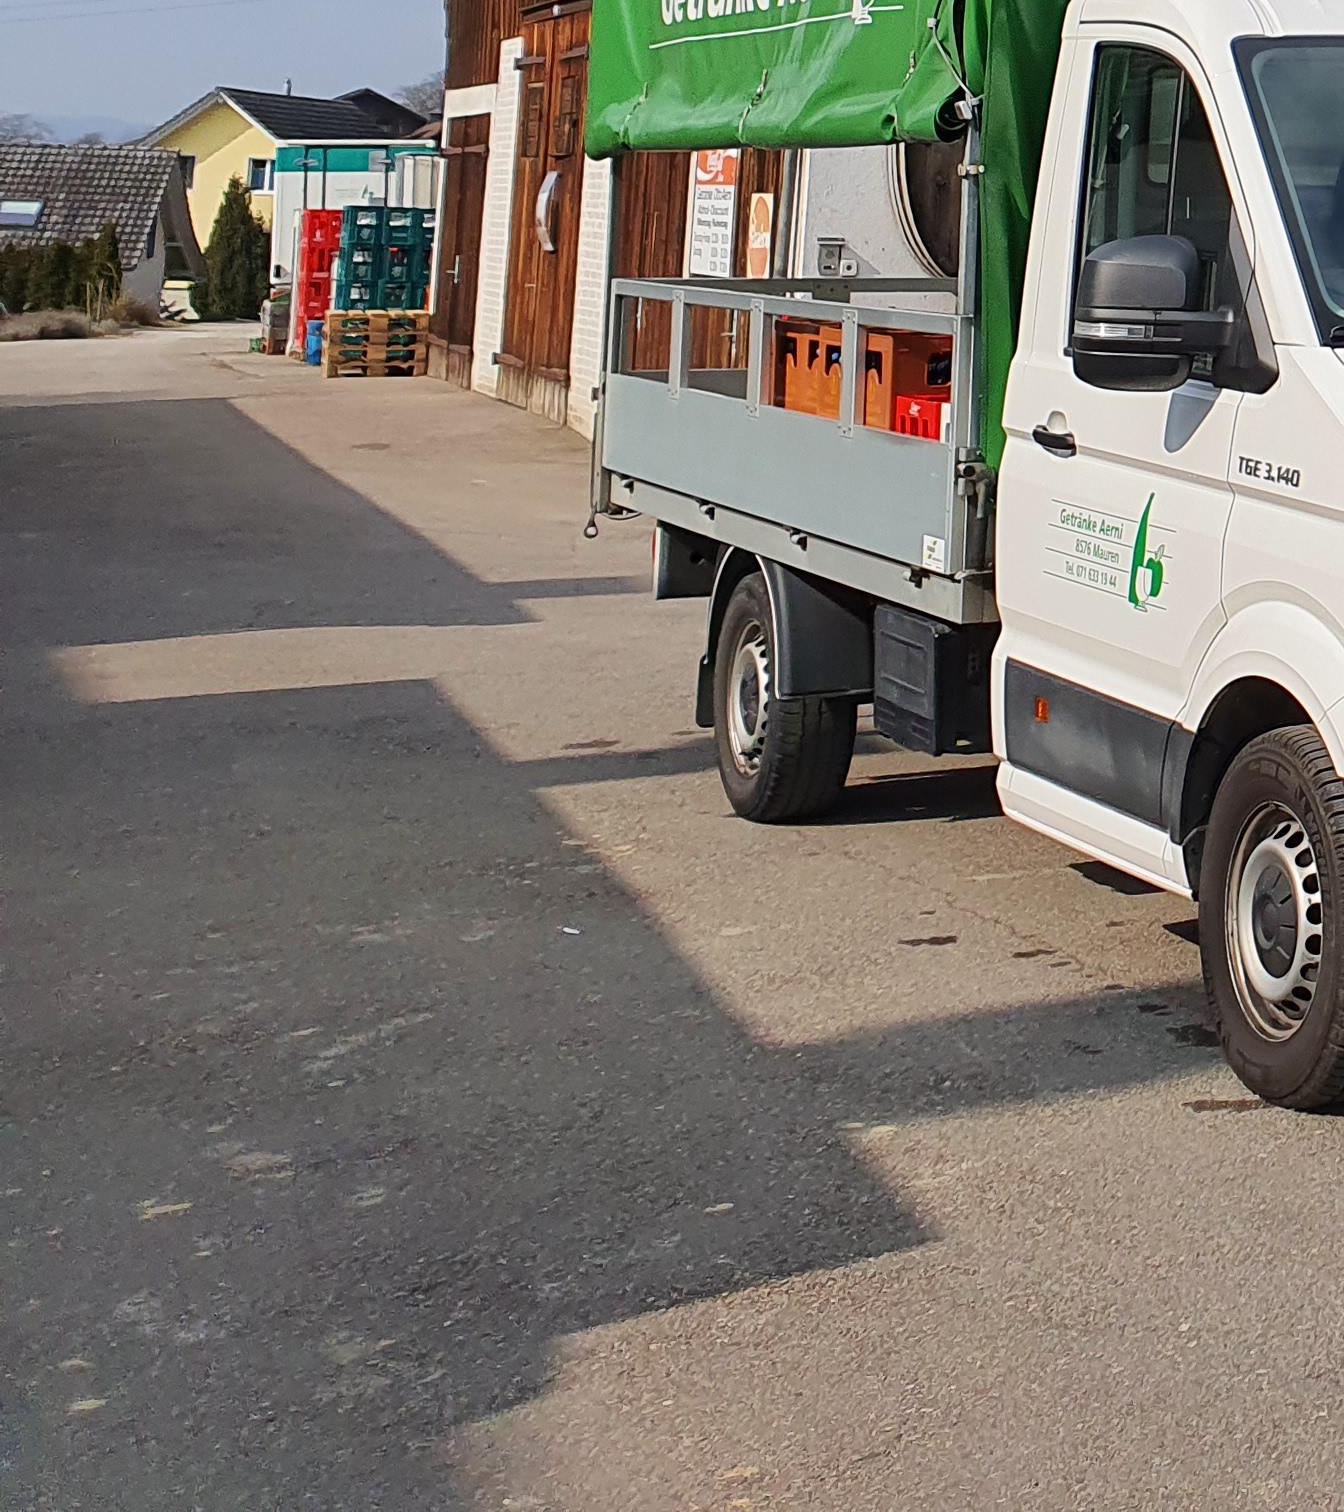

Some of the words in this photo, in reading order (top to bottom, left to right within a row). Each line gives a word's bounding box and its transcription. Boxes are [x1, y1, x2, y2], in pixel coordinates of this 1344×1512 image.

[1238, 455, 1262, 479] TGE
[1263, 462, 1301, 488] 3.140
[1059, 508, 1098, 533] Getränke
[1098, 518, 1124, 540] Aerni
[1075, 538, 1092, 556] 8576
[1092, 542, 1120, 565] Mauren
[1076, 562, 1087, 579] 071
